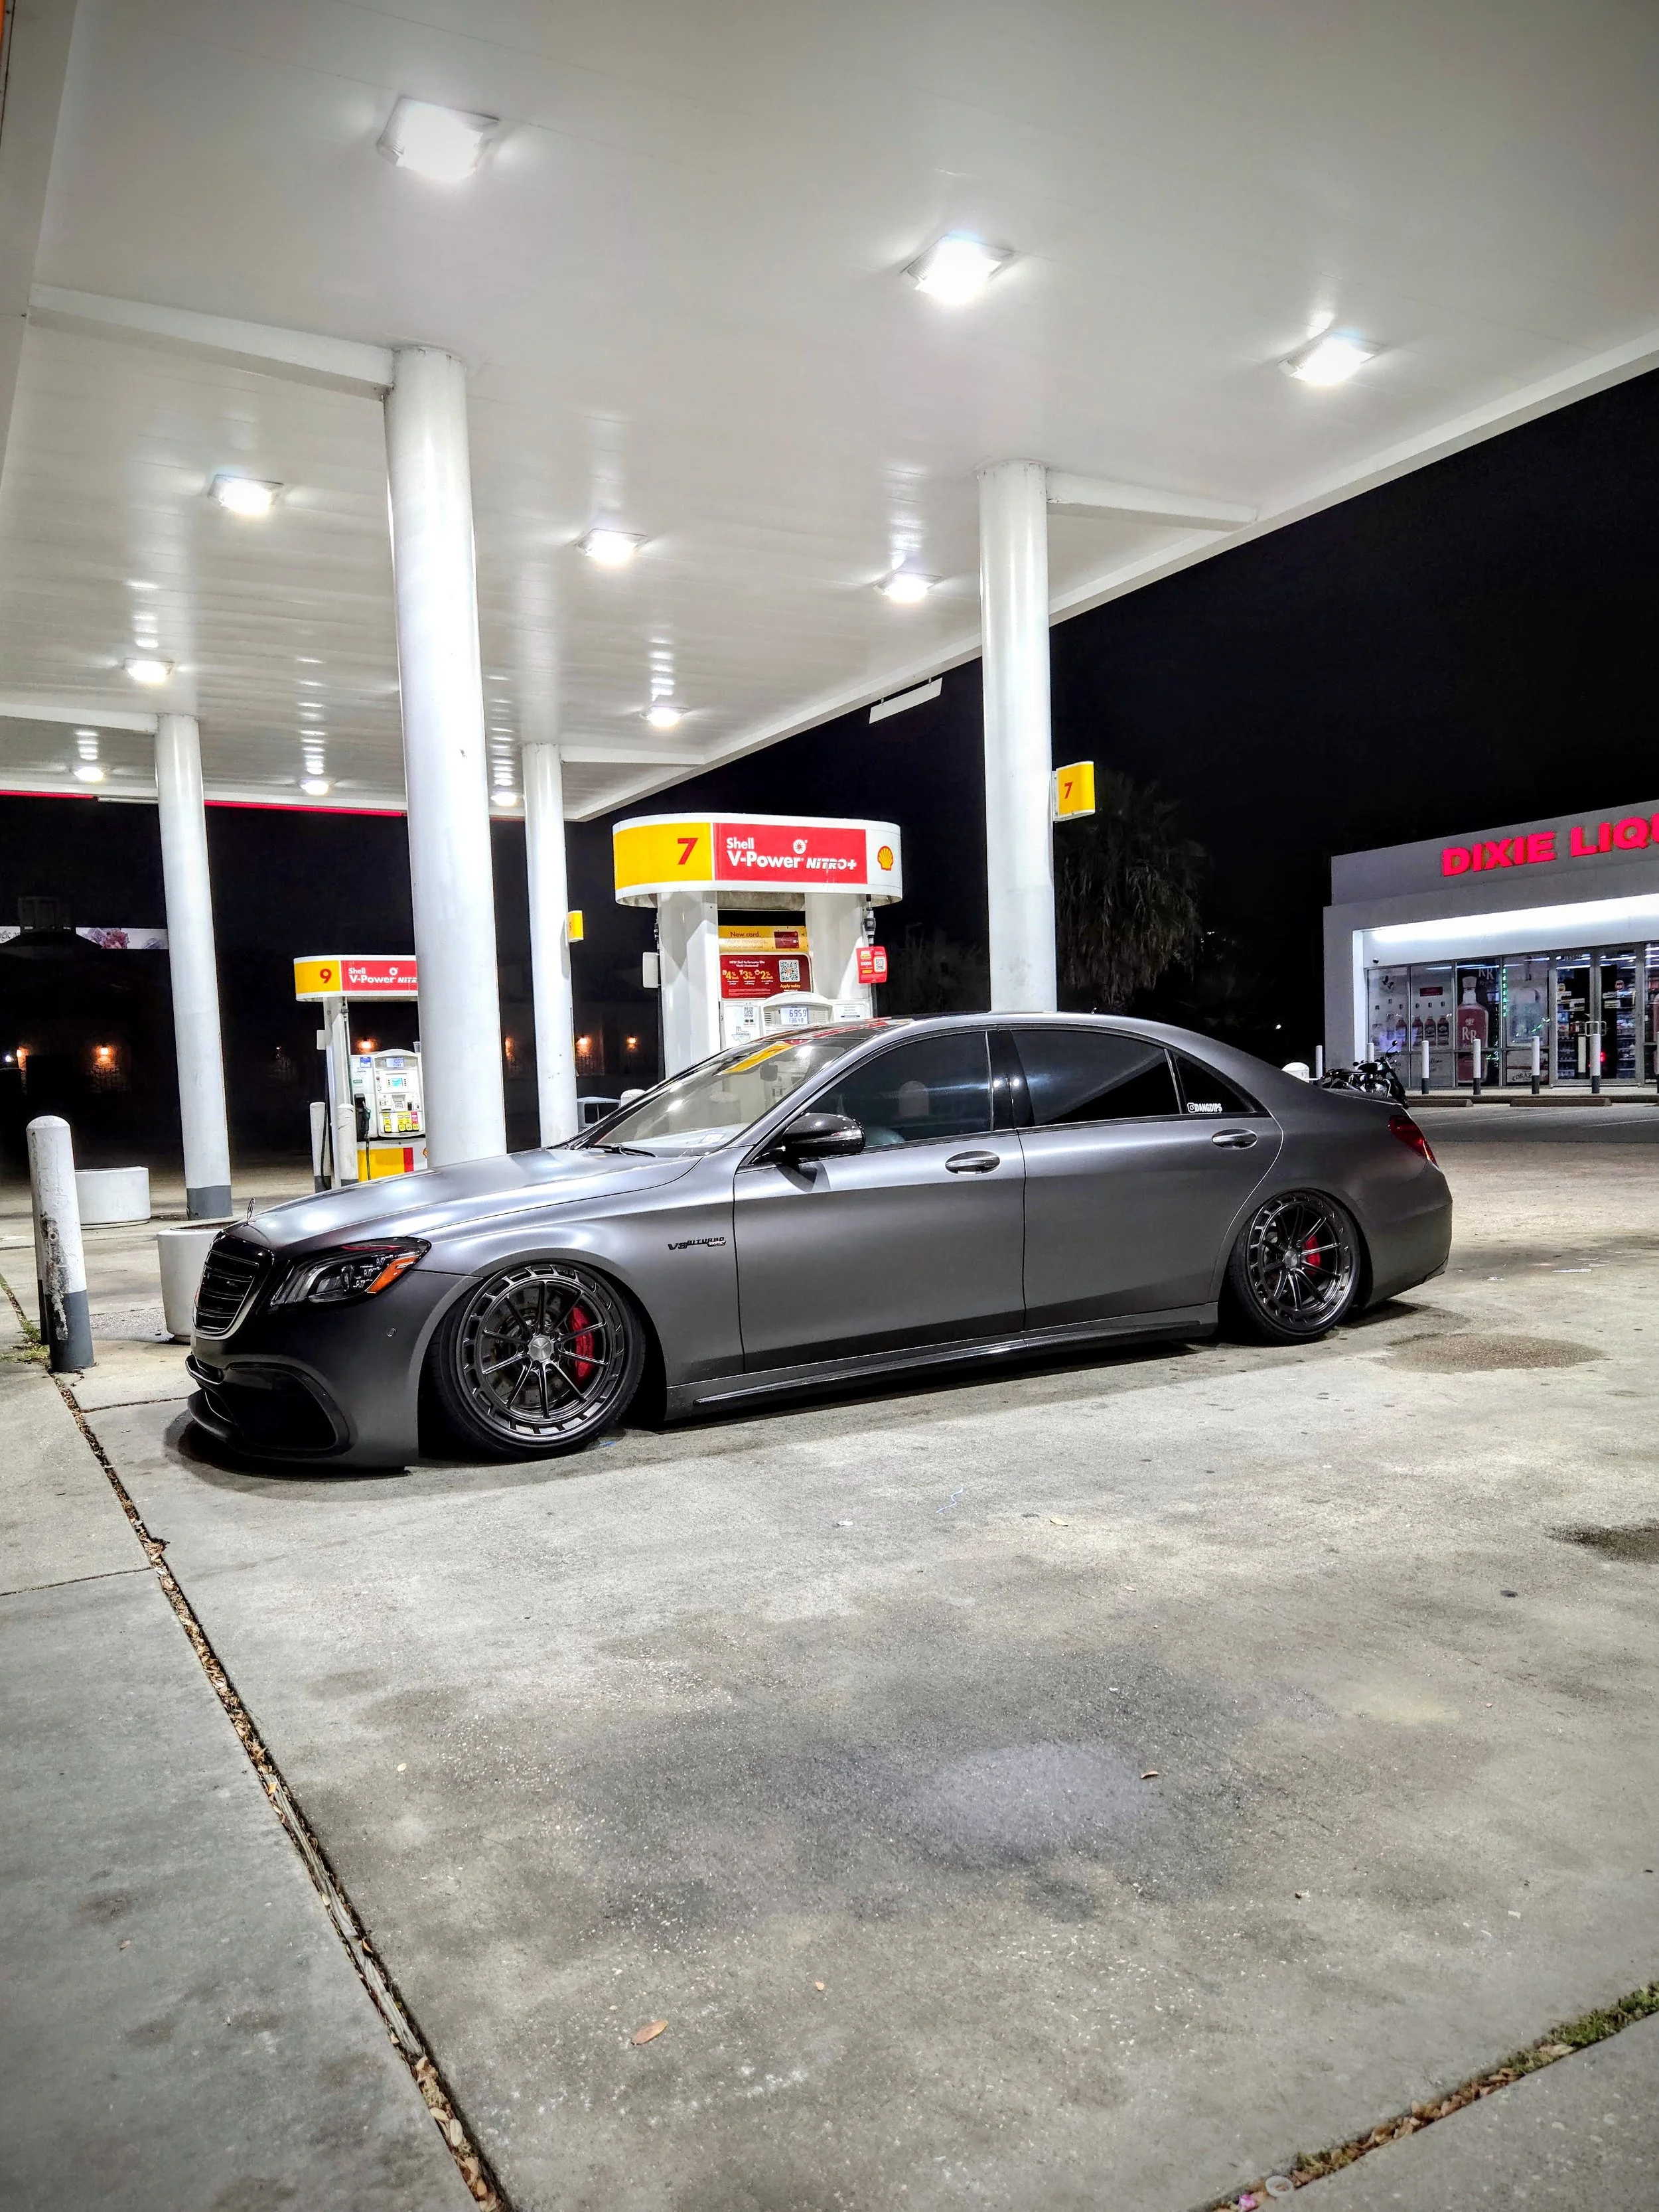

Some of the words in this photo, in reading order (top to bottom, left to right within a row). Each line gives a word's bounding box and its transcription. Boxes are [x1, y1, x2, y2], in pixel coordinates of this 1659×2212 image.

[1064, 782, 1073, 799] 7
[678, 838, 699, 865] 7
[727, 838, 755, 849] Shell
[1442, 832, 1555, 877] DIXIE
[1570, 812, 1659, 857] LIQ
[727, 850, 802, 868] V-Power
[320, 968, 332, 984] 9
[349, 975, 396, 984] V-Power
